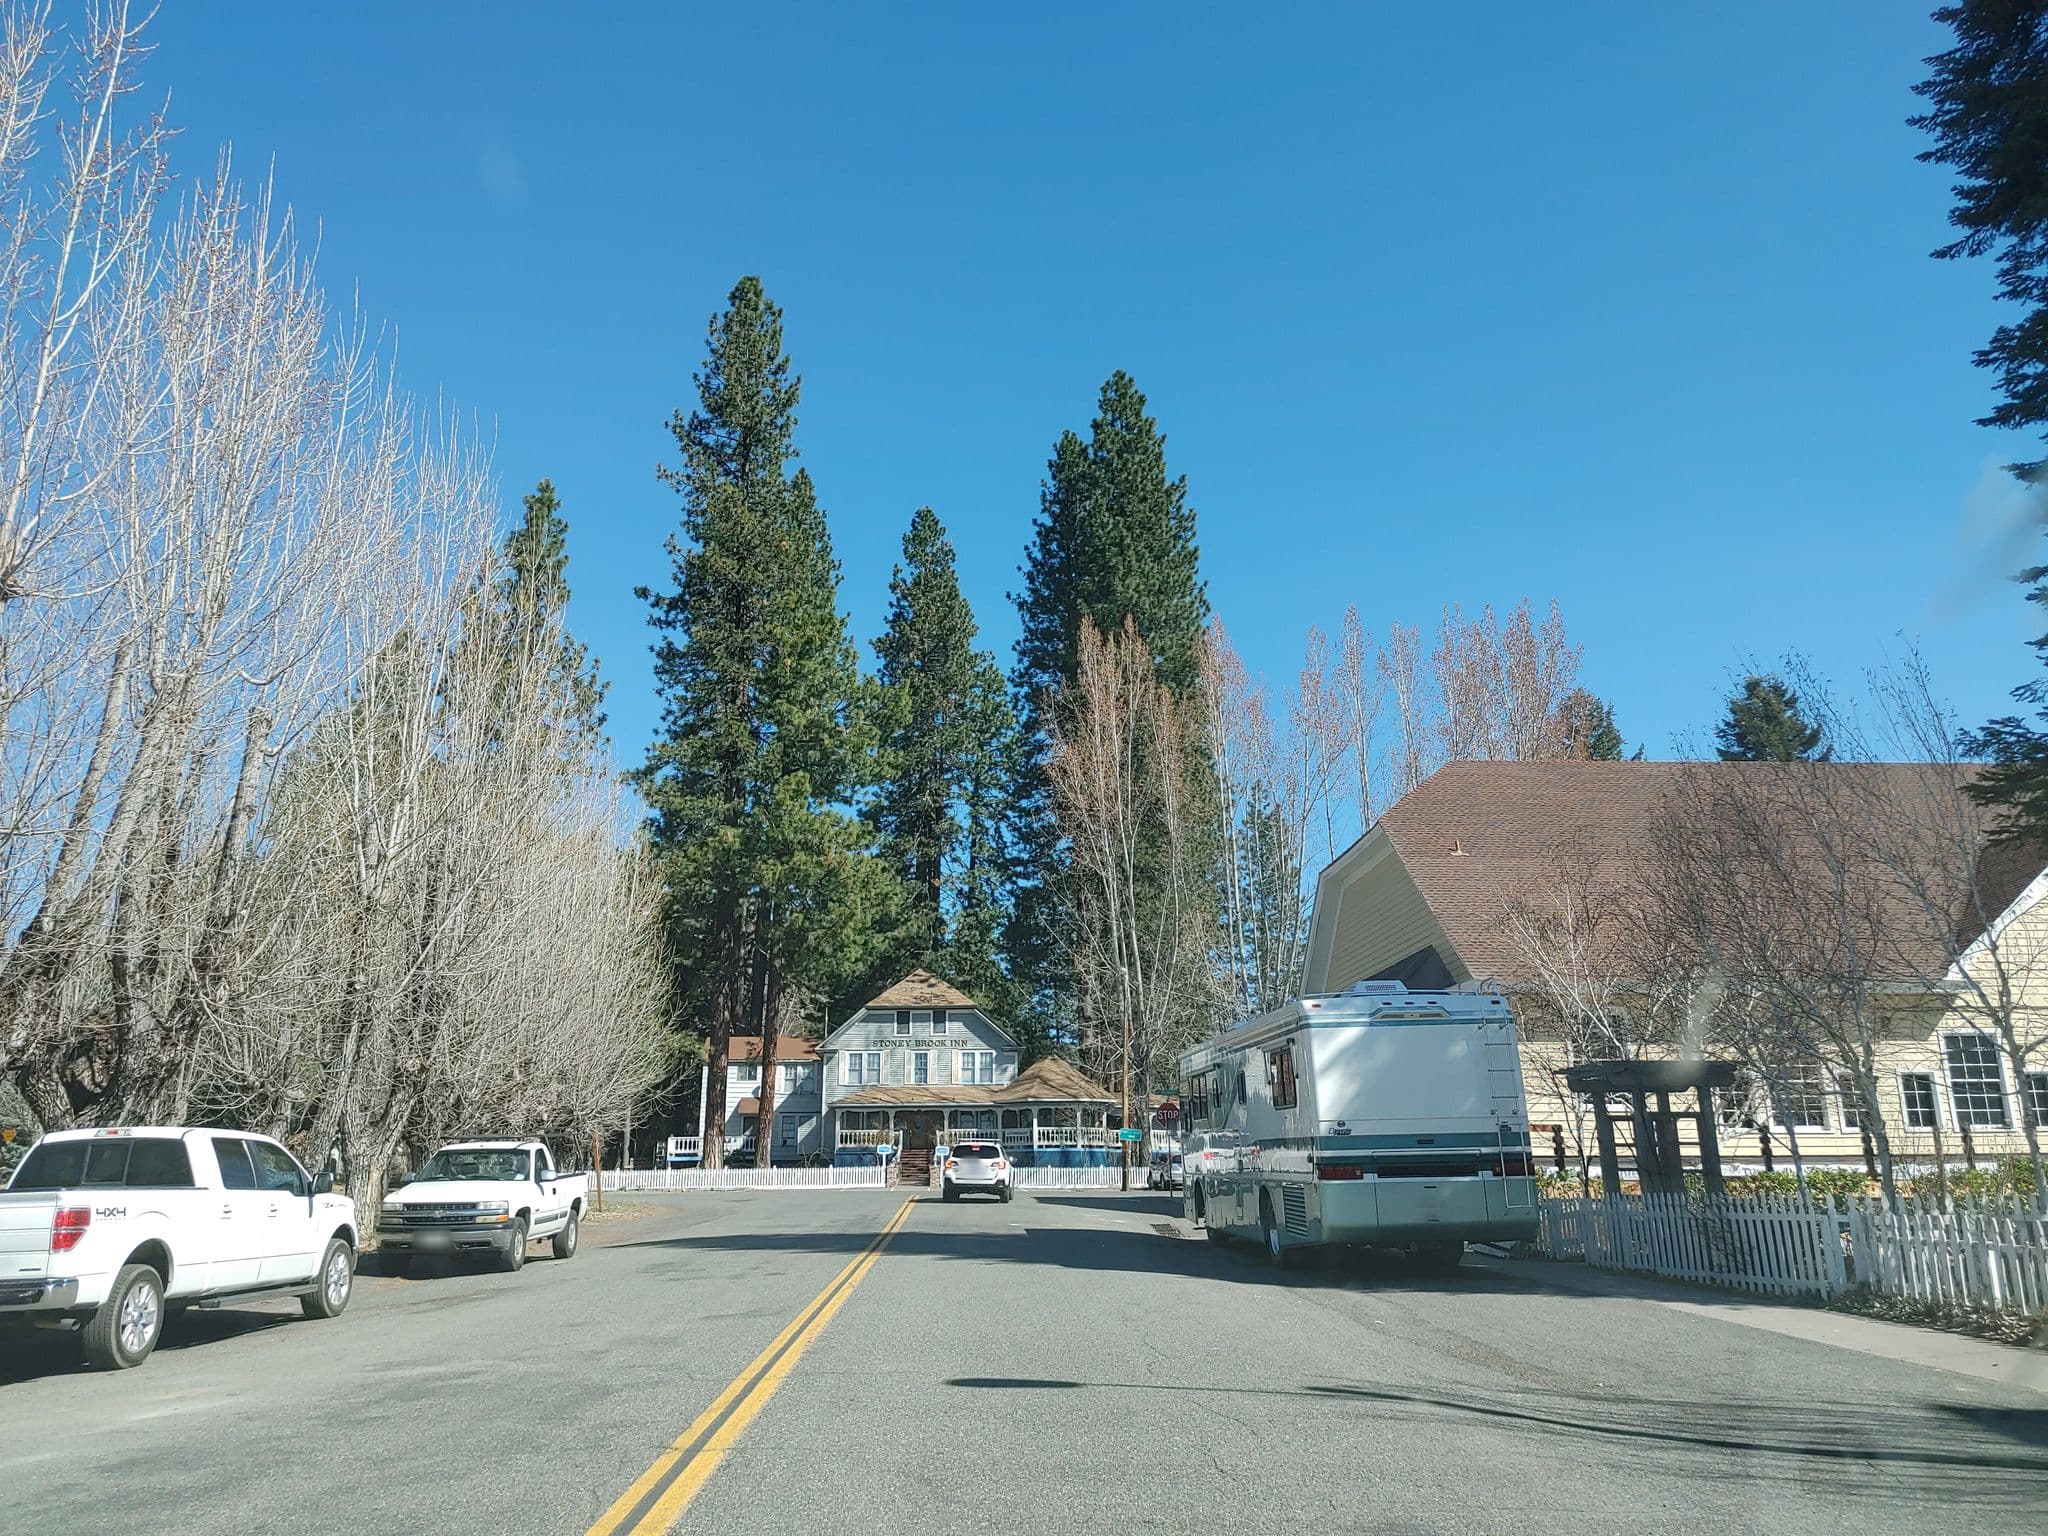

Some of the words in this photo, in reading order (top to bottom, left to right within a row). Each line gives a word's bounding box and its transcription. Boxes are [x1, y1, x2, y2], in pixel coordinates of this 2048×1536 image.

[872, 1039, 911, 1048] STONEY
[915, 1039, 946, 1048] BROOK
[950, 1039, 968, 1048] INN
[1158, 1110, 1179, 1120] STOP
